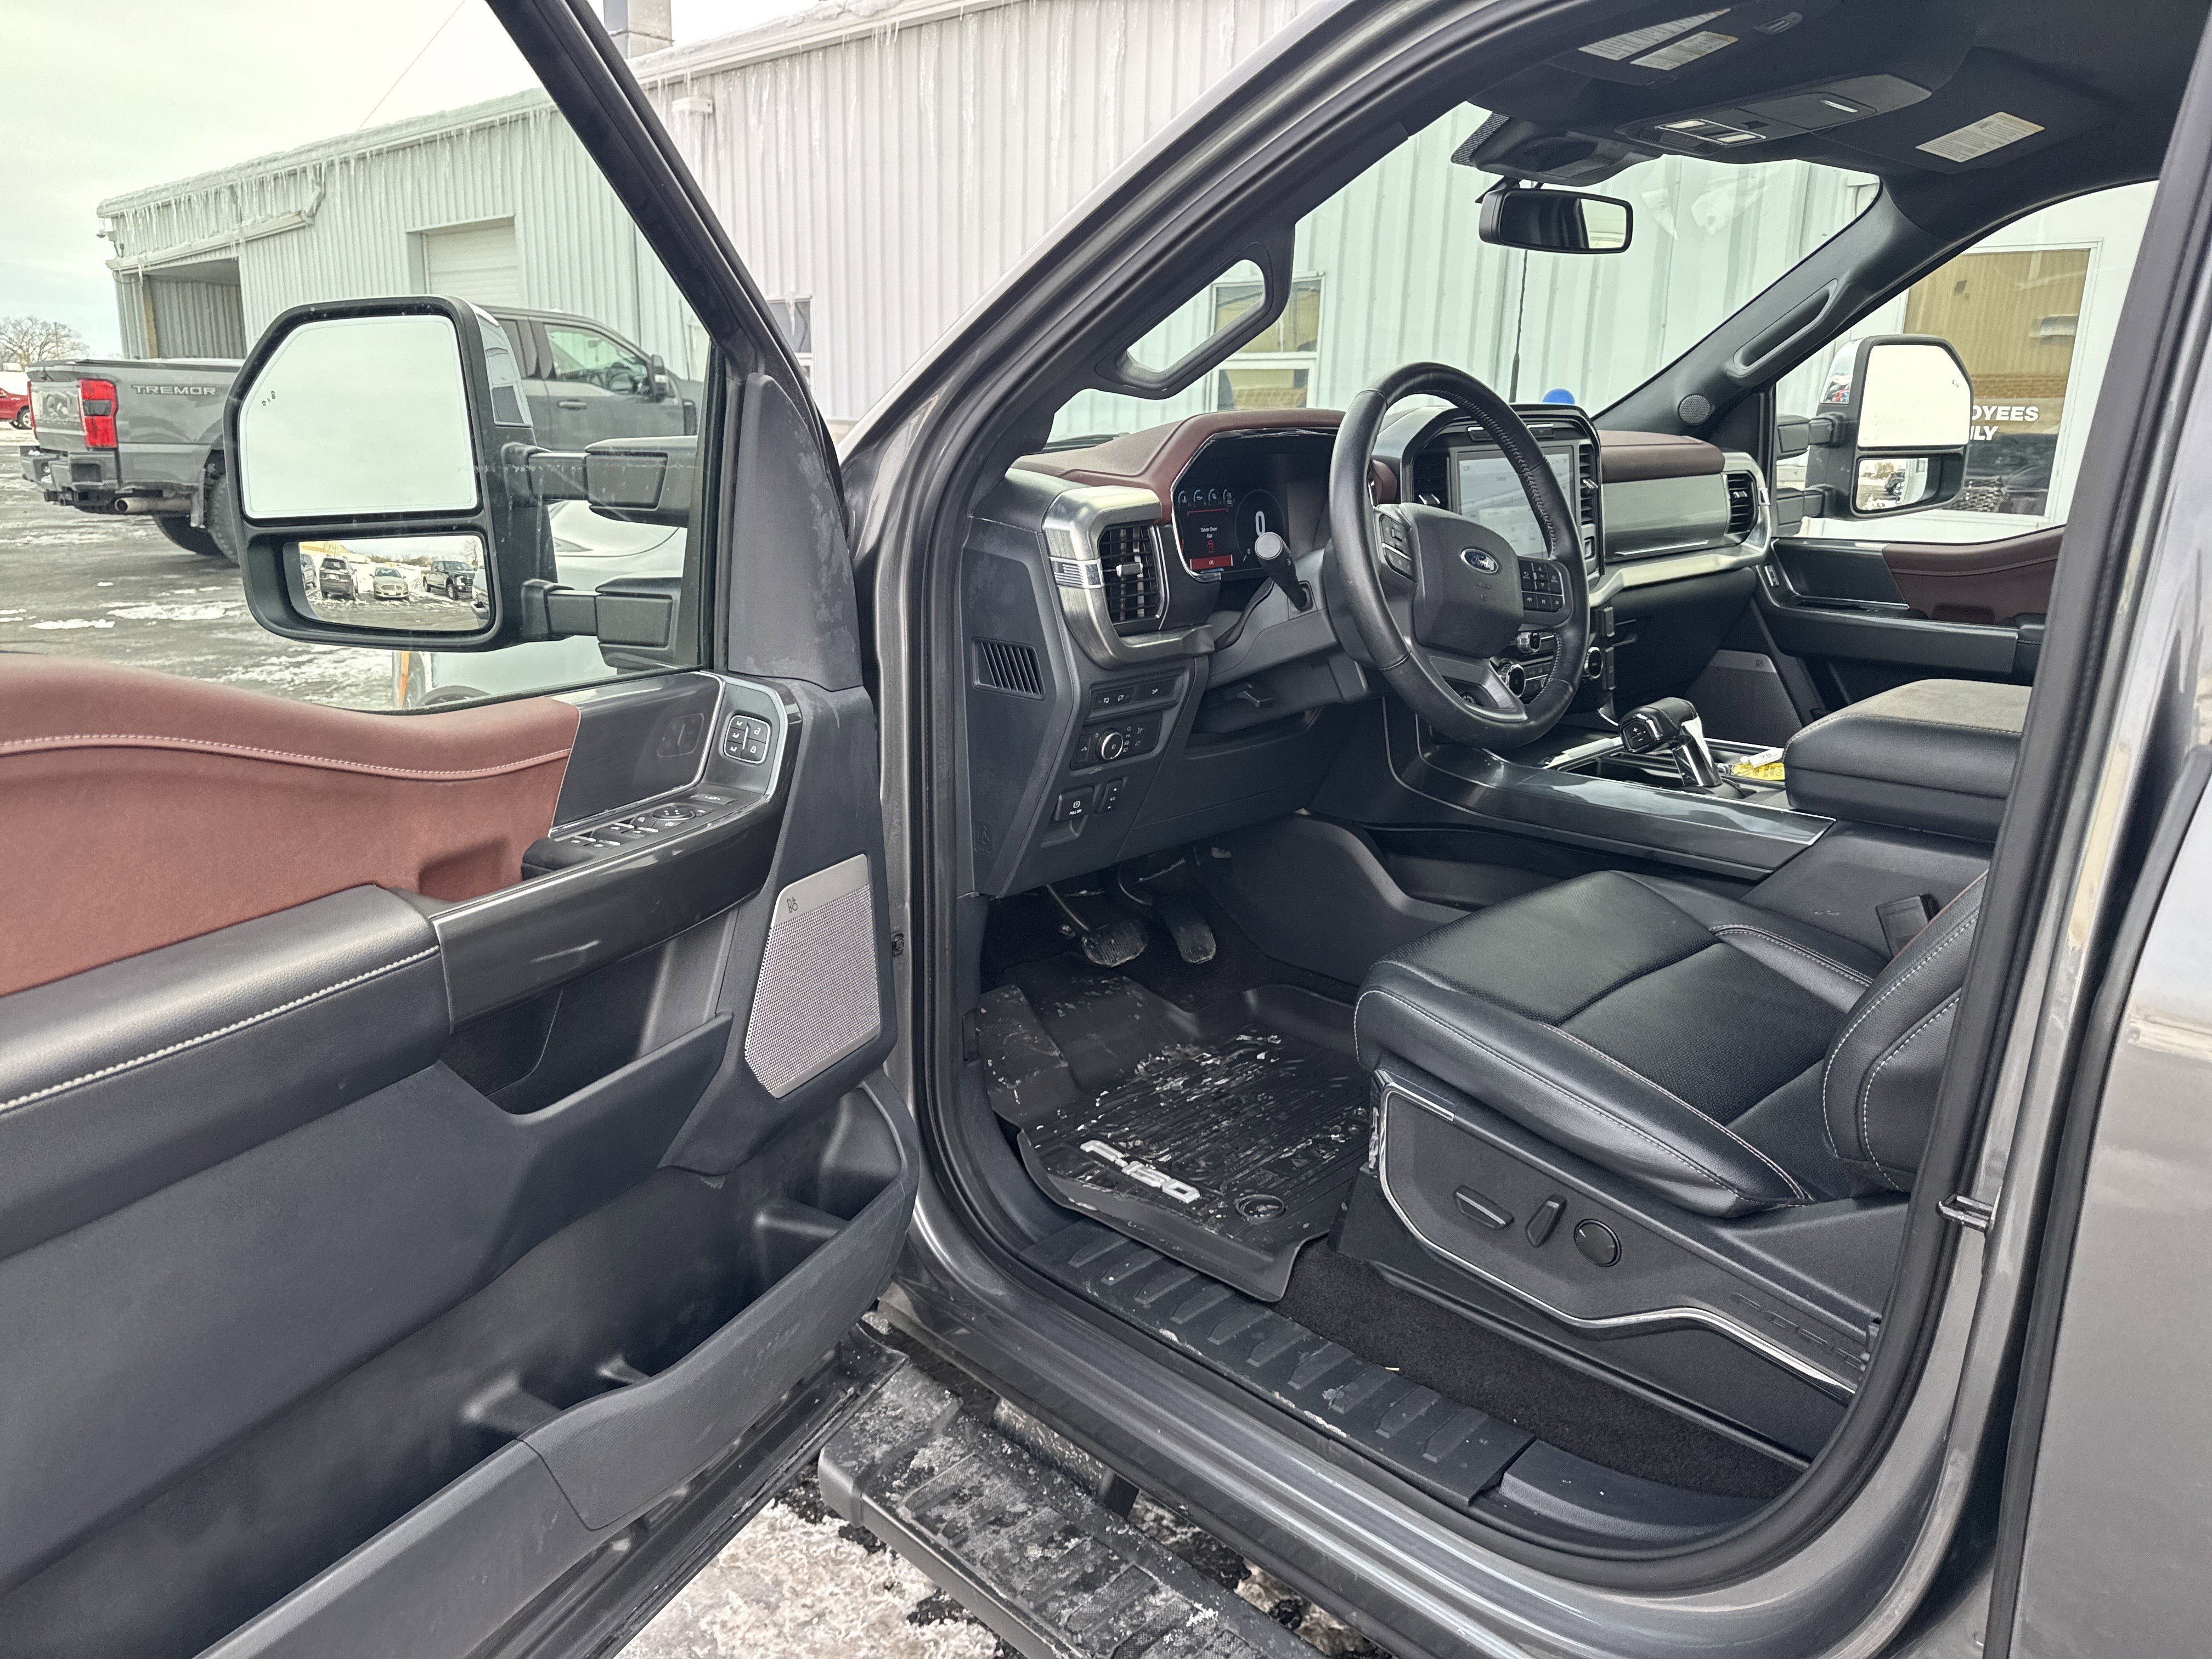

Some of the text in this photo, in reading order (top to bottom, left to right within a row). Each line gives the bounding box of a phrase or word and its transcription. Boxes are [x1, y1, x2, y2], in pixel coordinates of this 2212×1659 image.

[131, 385, 217, 395] TREMOR
[1972, 405, 2039, 421] OYEES
[1255, 511, 1266, 536] 0
[1080, 1140, 1201, 1204] F-150
